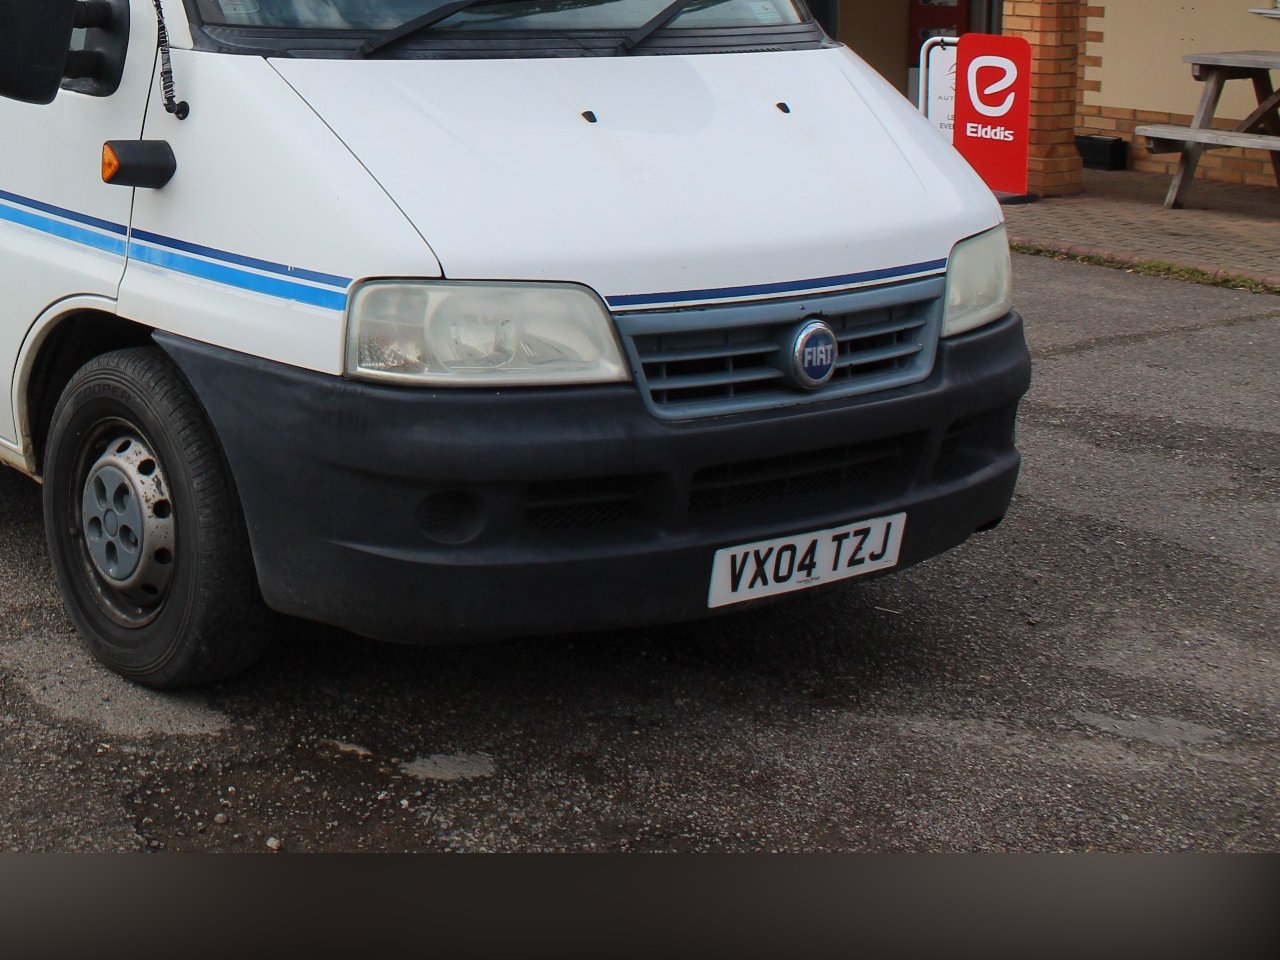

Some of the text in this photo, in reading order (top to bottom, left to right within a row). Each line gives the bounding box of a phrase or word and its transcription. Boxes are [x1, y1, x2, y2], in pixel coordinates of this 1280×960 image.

[966, 122, 1015, 142] Elddis
[804, 344, 833, 368] FIAT
[730, 521, 892, 593] VX04 TZJ
